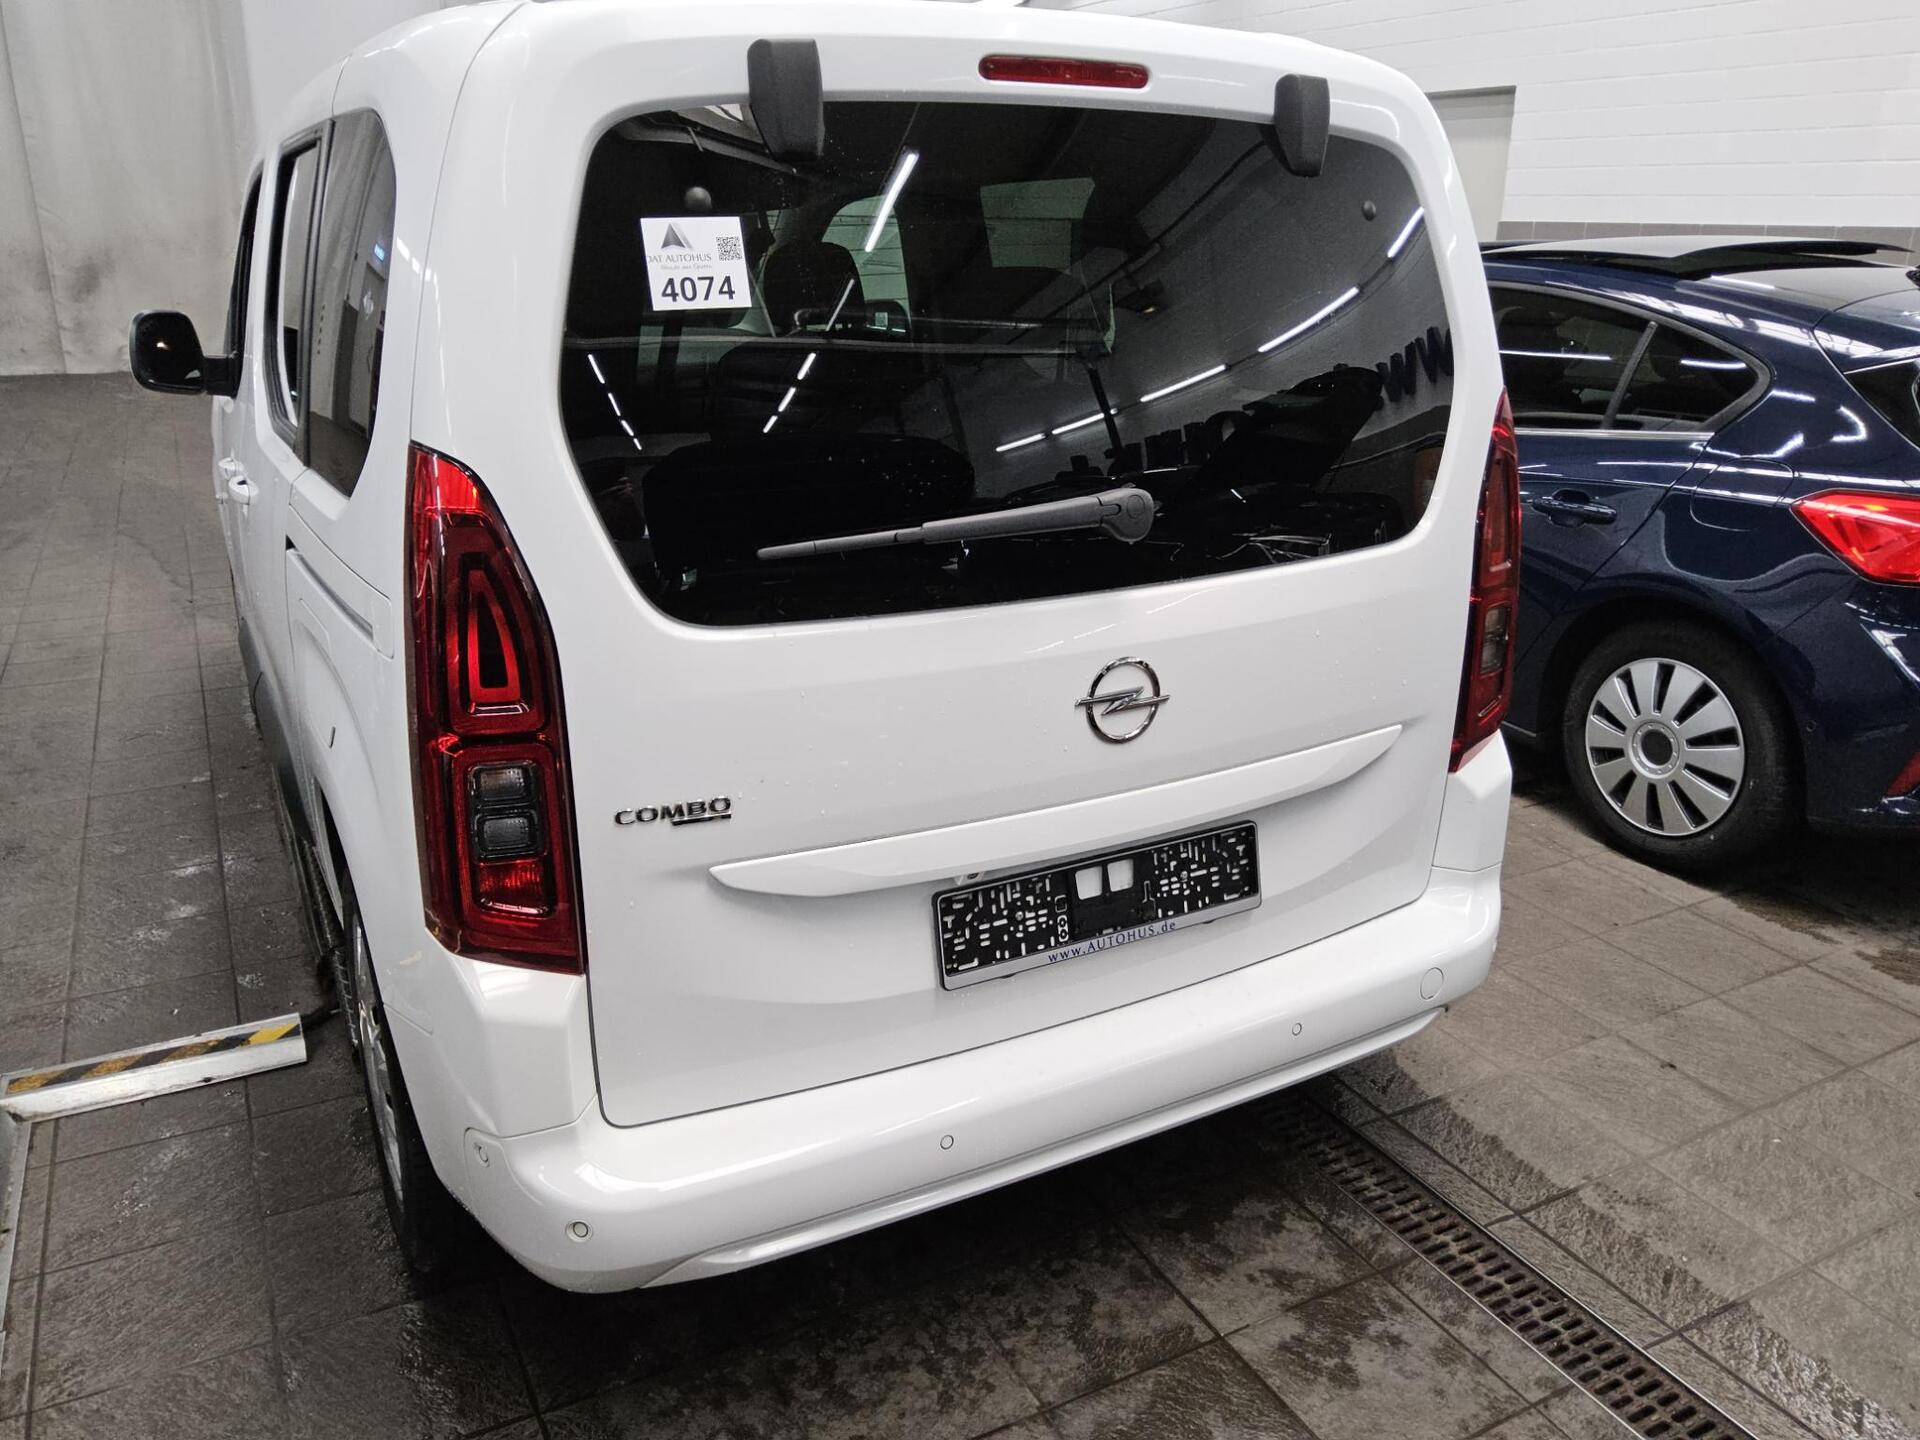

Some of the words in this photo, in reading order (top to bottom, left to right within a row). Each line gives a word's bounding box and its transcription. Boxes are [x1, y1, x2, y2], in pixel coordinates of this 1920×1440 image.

[666, 253, 712, 262] AUTOHUS
[661, 275, 735, 302] 4074
[614, 797, 732, 826] COMBO
[1048, 920, 1177, 963] www.AUTOHUS.de
